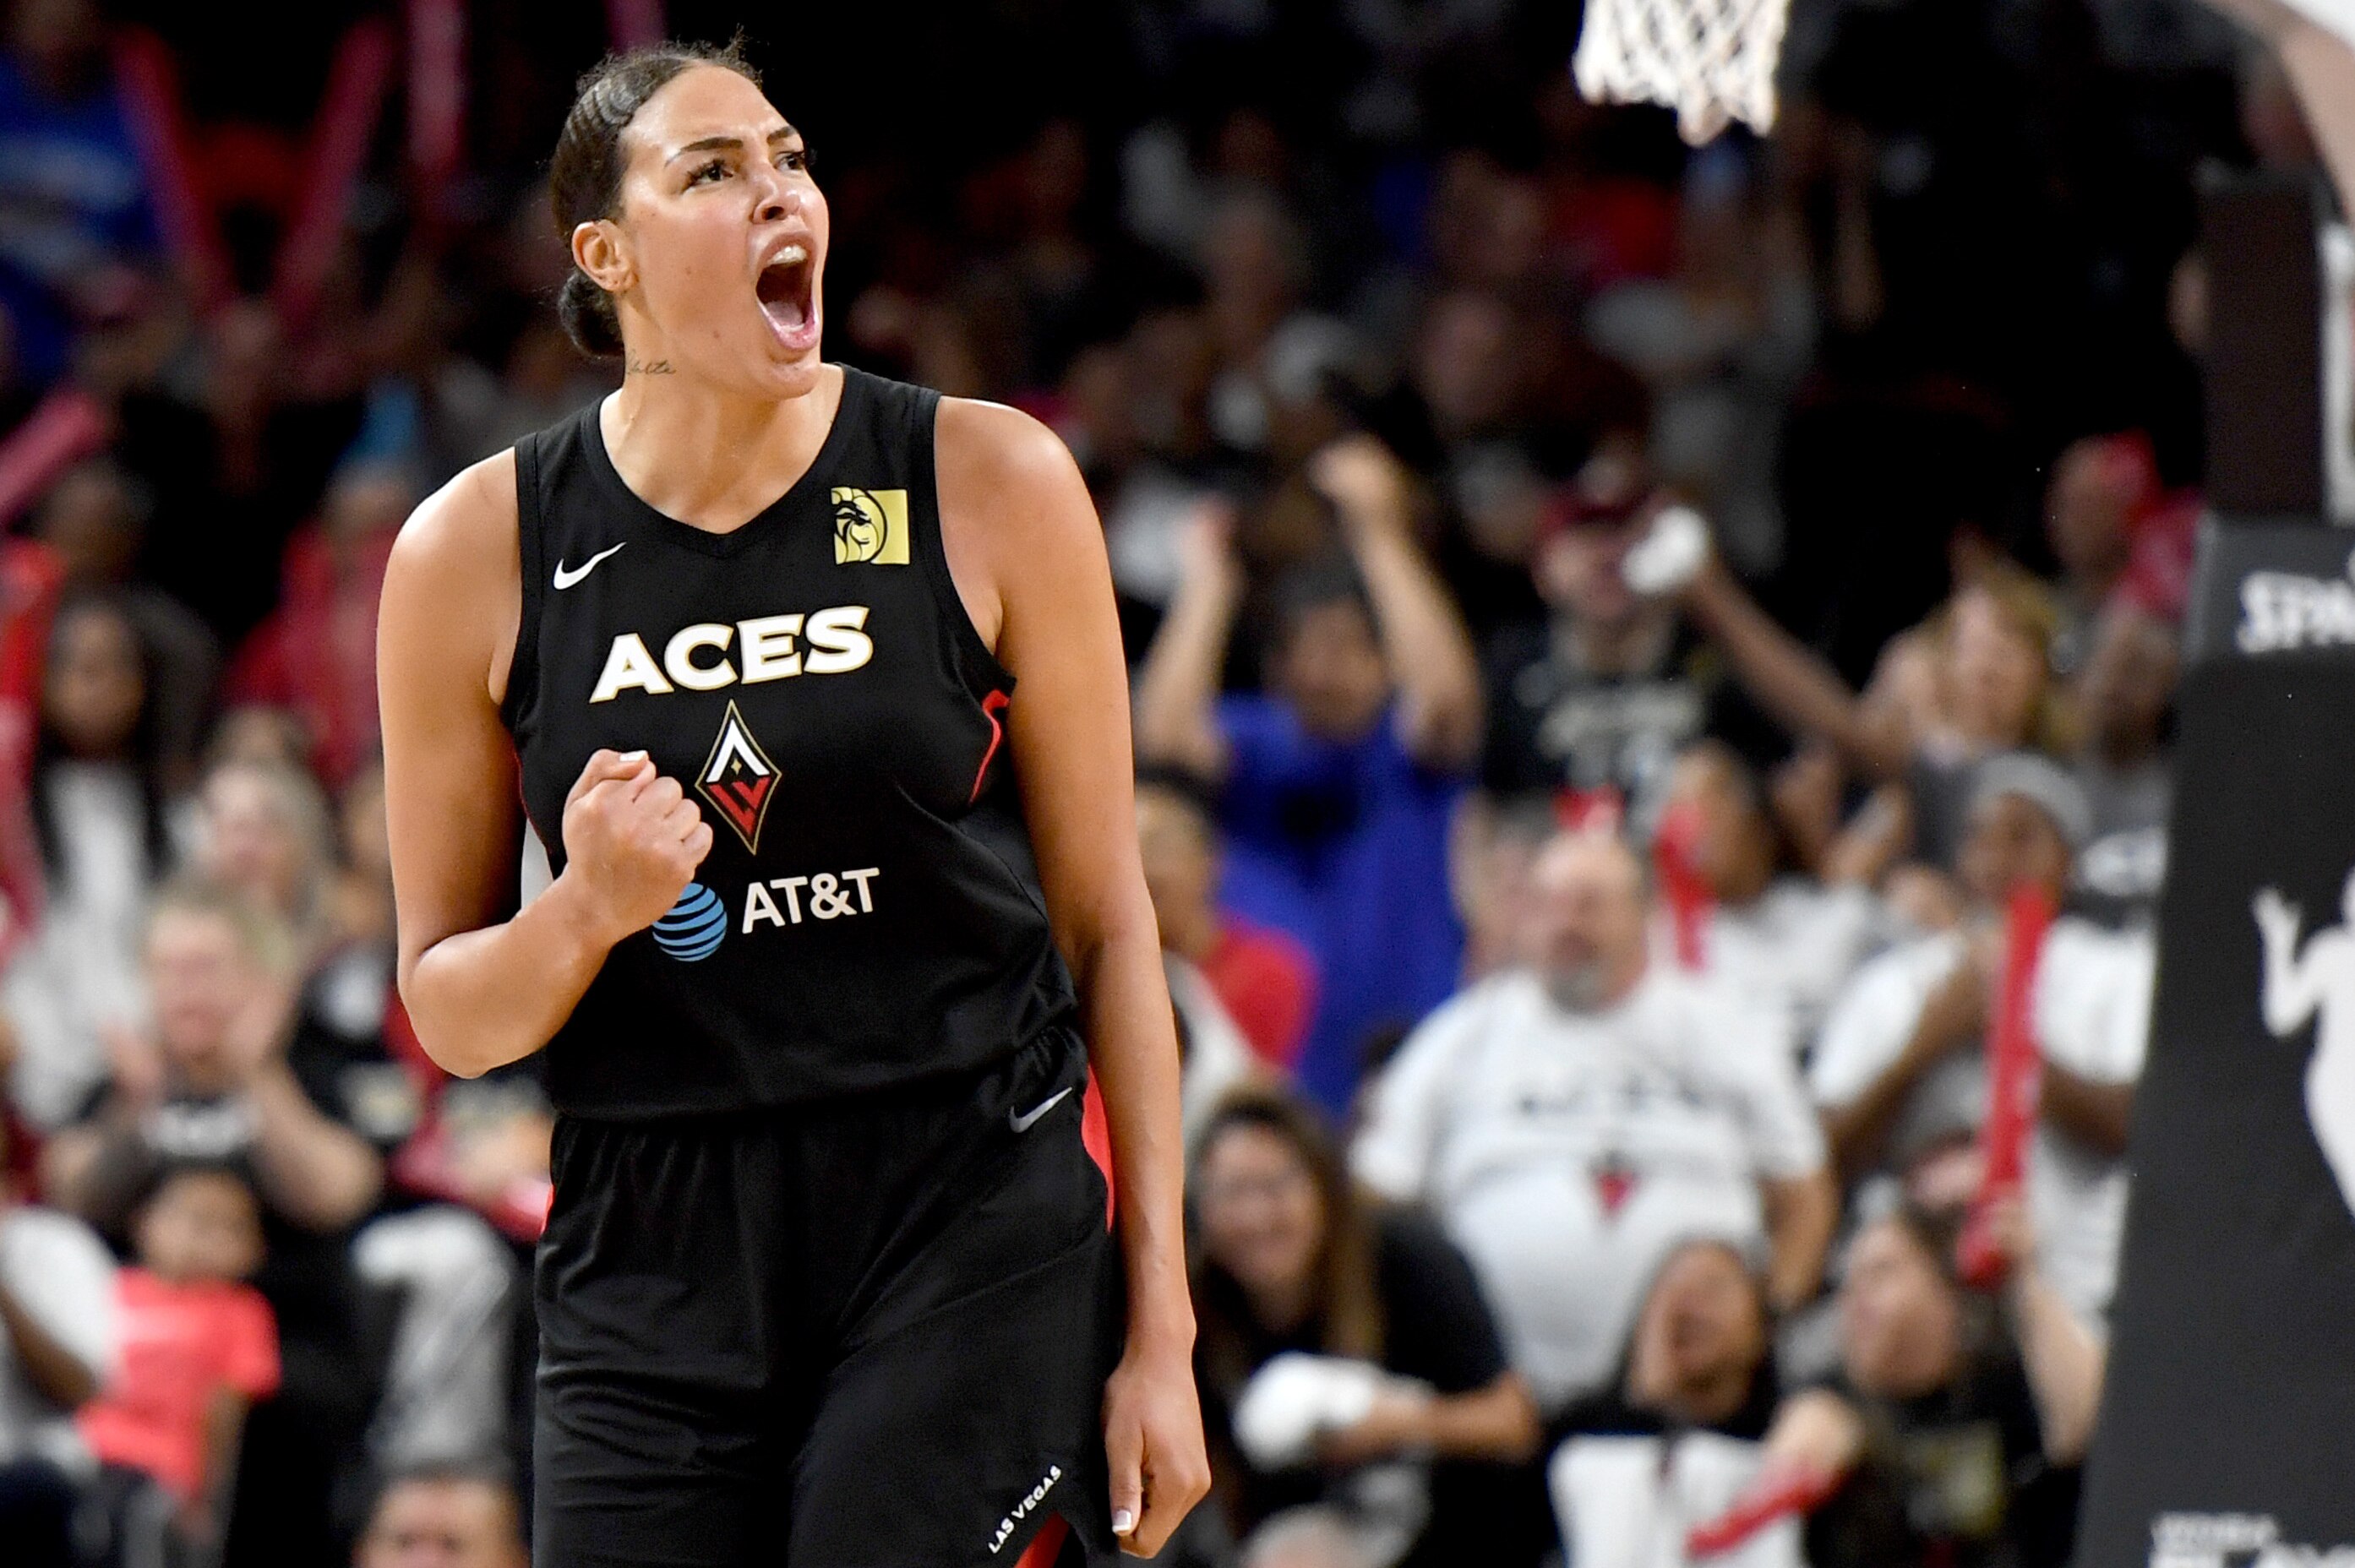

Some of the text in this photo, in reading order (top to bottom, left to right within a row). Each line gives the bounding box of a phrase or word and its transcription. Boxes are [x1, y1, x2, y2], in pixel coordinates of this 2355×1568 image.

[589, 605, 874, 703] ACES
[742, 867, 880, 934] AT&T
[988, 1465, 1061, 1554] LAS VEGAS
